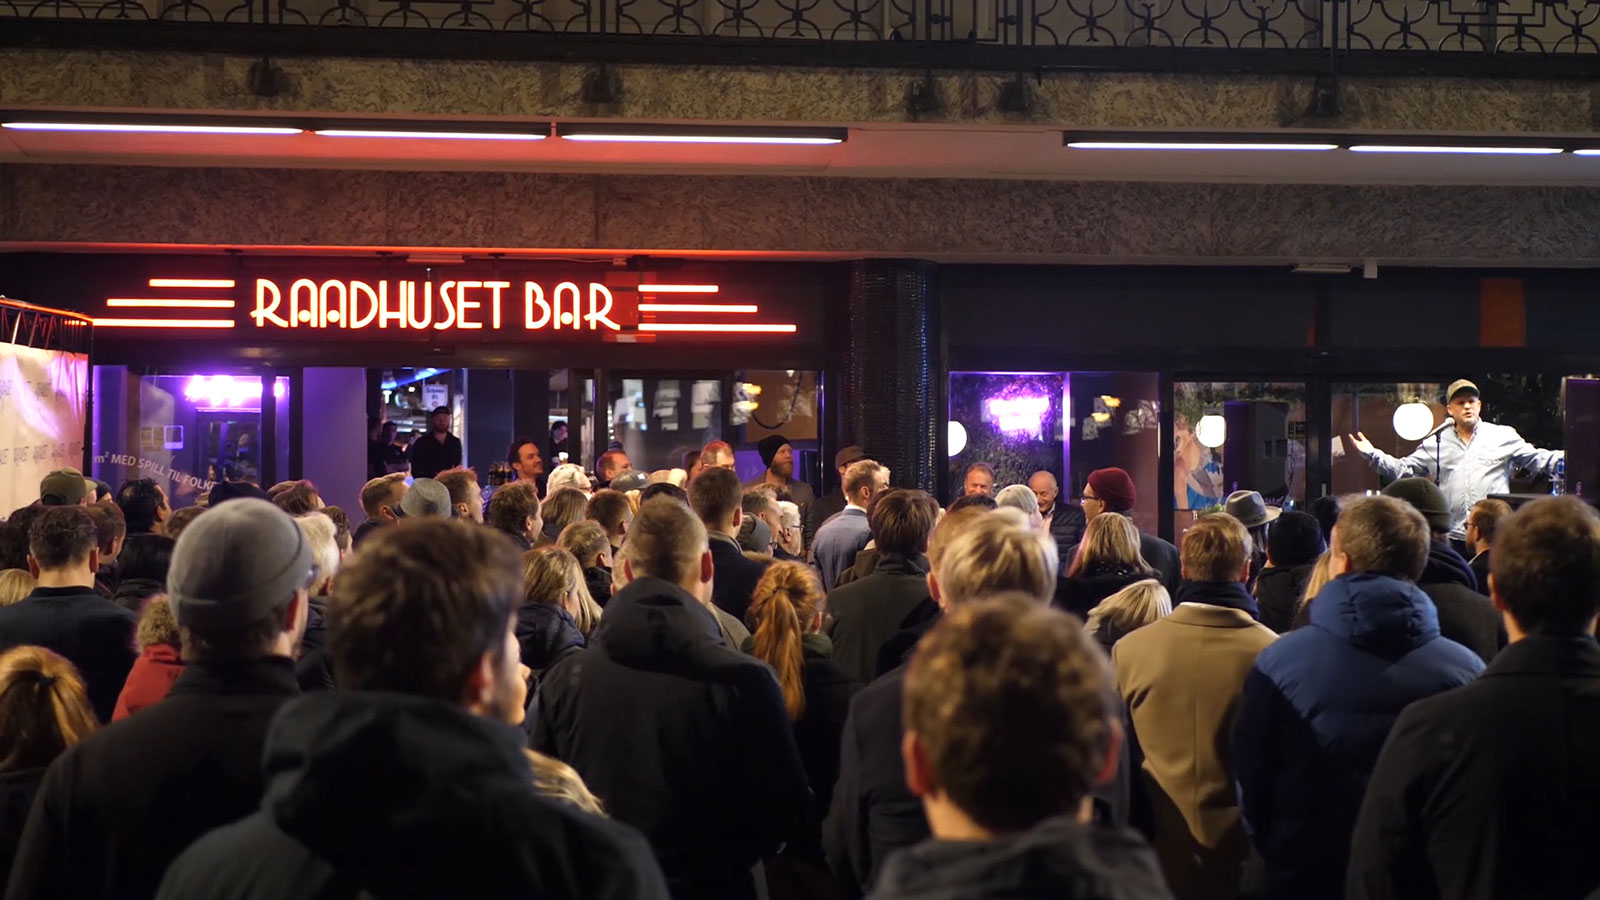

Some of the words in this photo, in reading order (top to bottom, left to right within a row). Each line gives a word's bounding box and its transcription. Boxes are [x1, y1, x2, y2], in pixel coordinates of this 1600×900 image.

[250, 278, 510, 330] RAADHUSET
[524, 281, 621, 331] BAR
[111, 453, 137, 467] MED
[138, 457, 165, 477] SPILL
[167, 468, 182, 483] TIL
